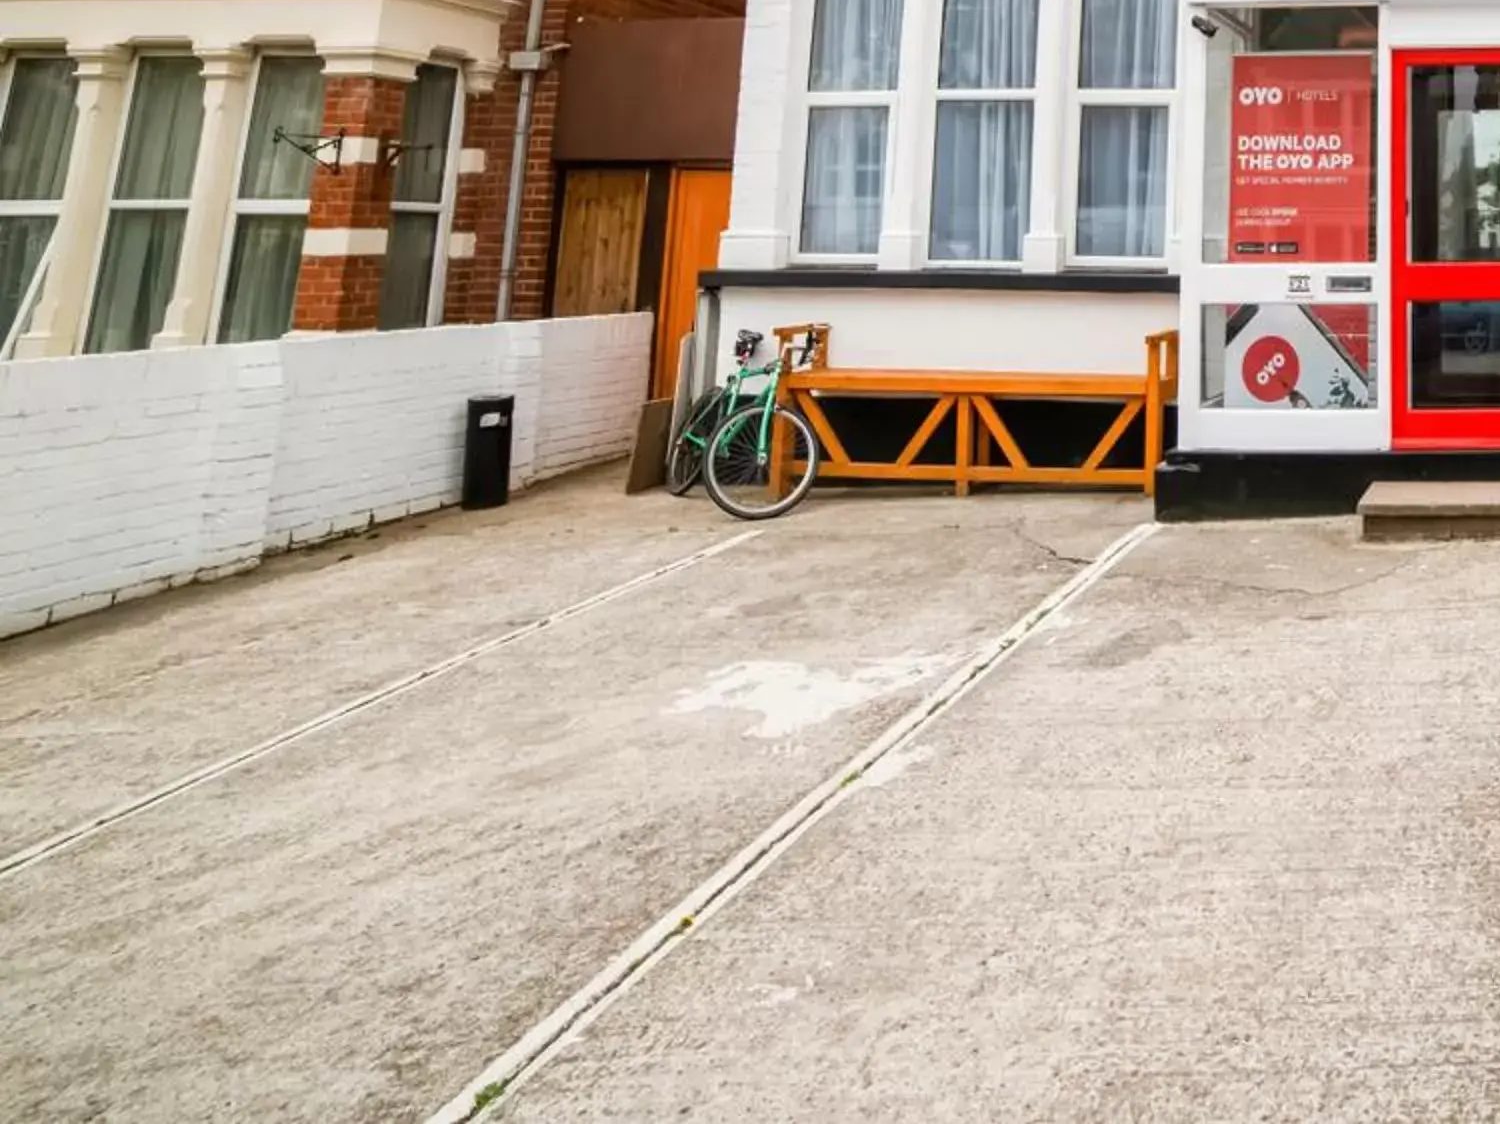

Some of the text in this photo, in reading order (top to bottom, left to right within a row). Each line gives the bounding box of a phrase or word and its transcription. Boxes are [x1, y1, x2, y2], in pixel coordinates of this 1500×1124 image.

[1239, 86, 1339, 105] OYO HOTELS
[1237, 134, 1342, 151] DOWNLOAD
[1237, 153, 1355, 171] THE OYO APP
[1256, 352, 1286, 385] OYO
